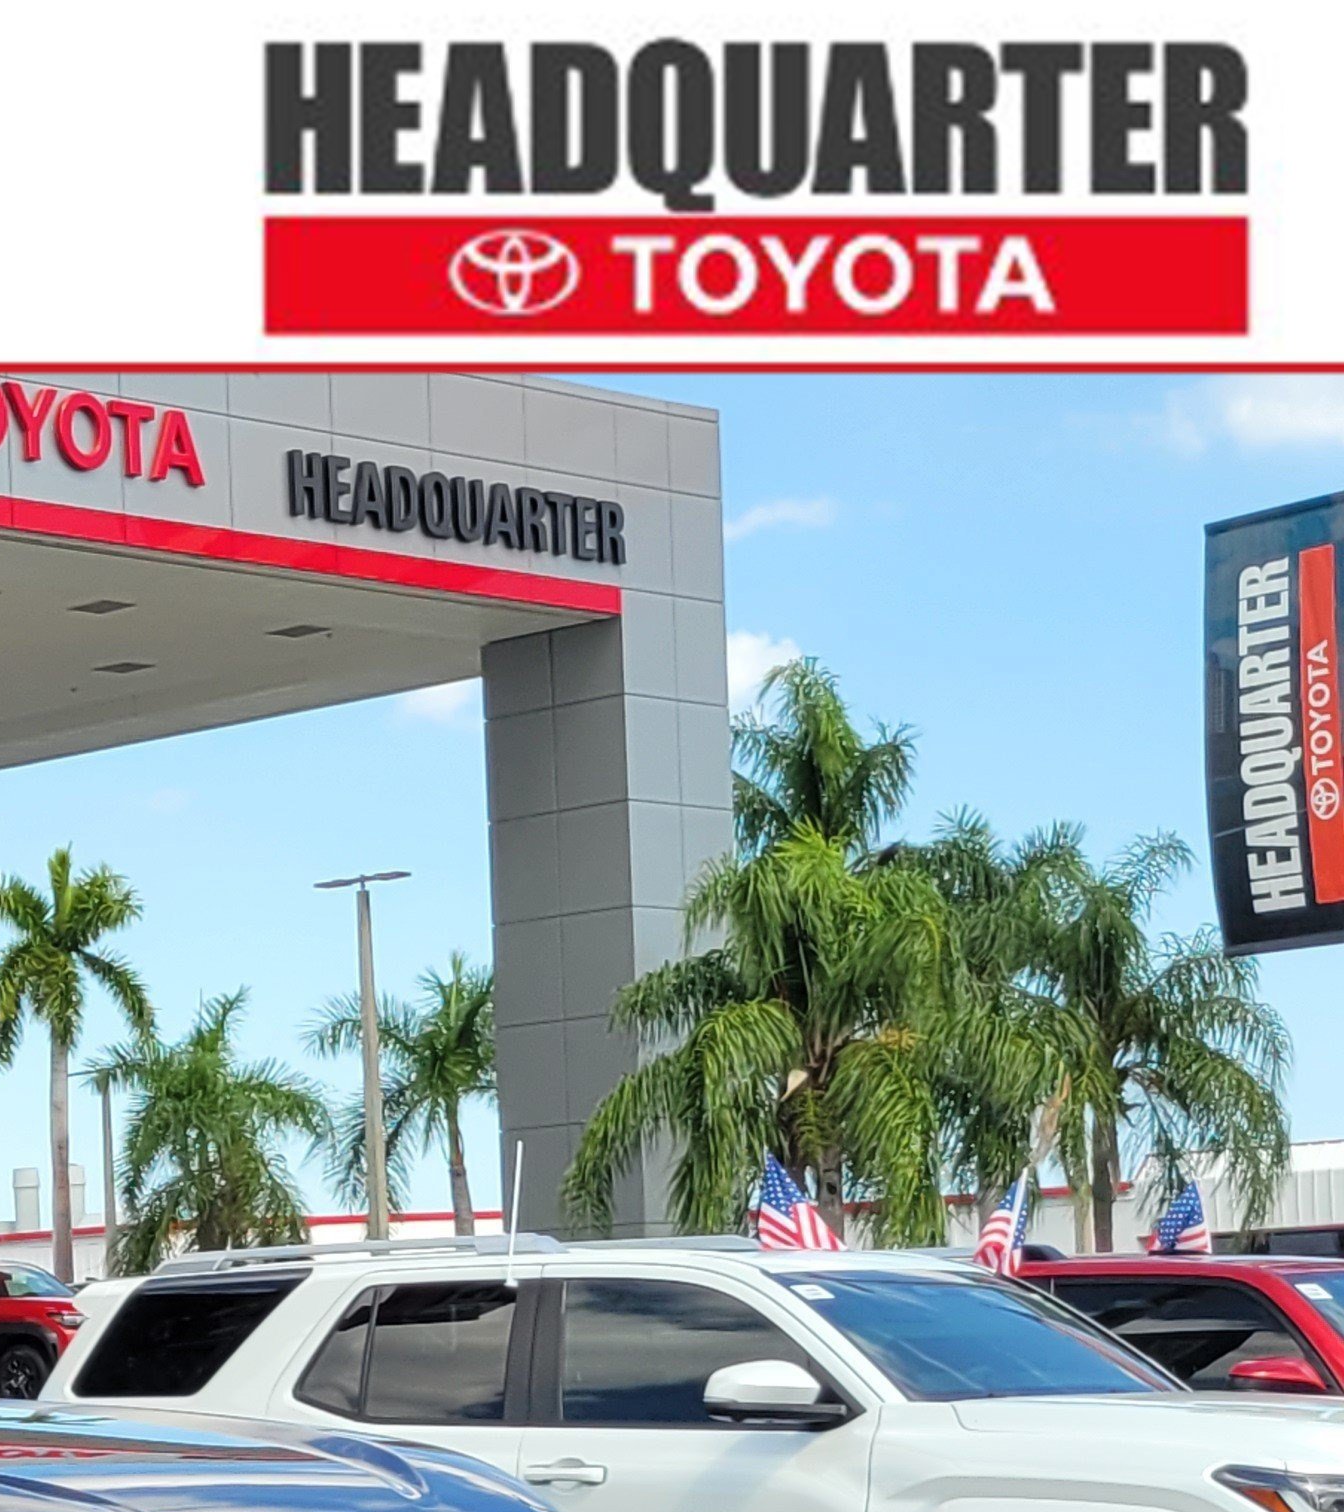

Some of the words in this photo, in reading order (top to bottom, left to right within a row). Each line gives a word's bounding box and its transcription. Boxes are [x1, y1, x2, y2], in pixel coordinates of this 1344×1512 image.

[286, 449, 626, 564] HEADQUARTER
[1238, 556, 1306, 914] HEADQUARTER
[1307, 639, 1334, 776] TOYOTA
